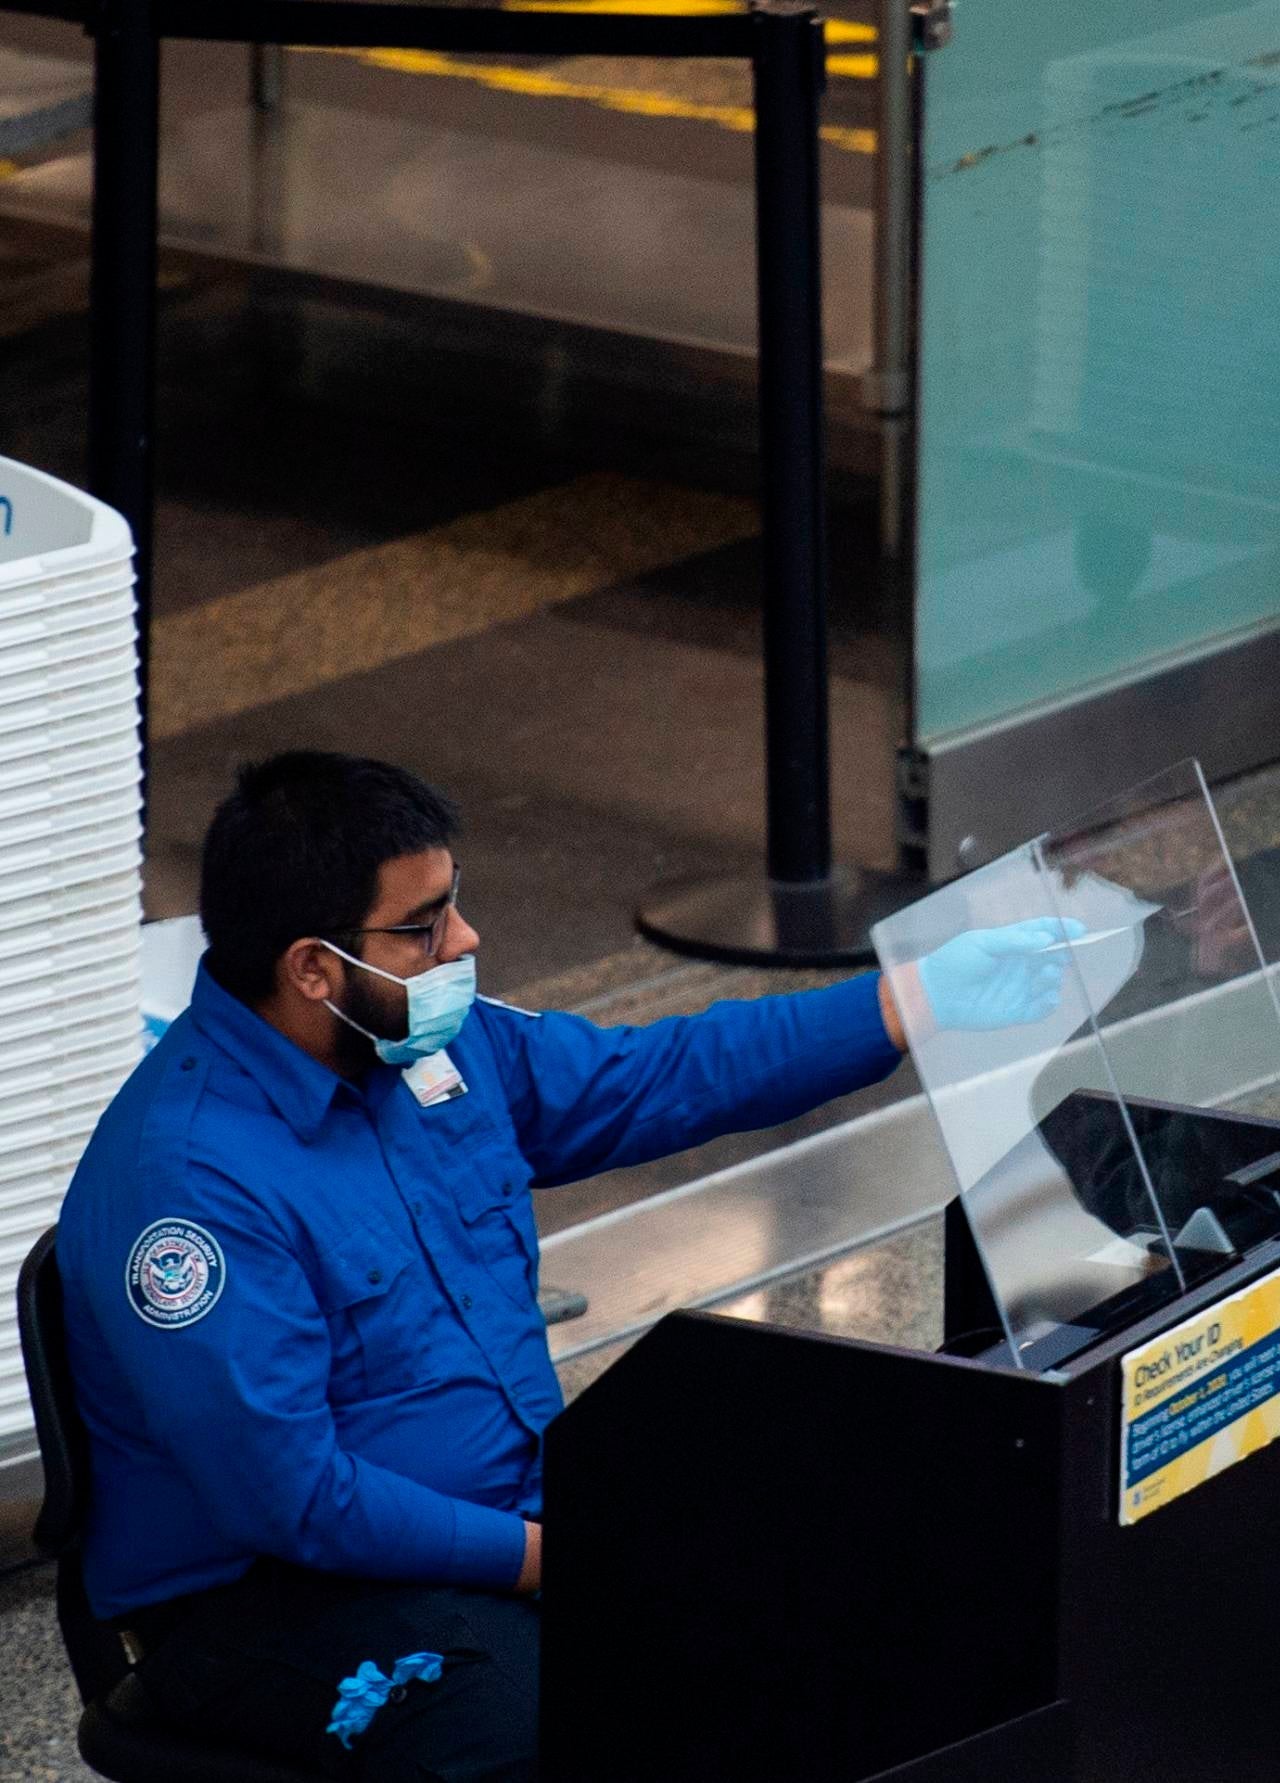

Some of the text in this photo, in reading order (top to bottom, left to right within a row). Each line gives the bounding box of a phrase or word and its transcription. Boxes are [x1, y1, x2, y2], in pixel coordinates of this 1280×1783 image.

[132, 1227, 217, 1285] TRANSPORTATION SECURITY
[142, 1289, 214, 1321] ADMINISTRATION
[1135, 1323, 1220, 1386] Check Your ID
